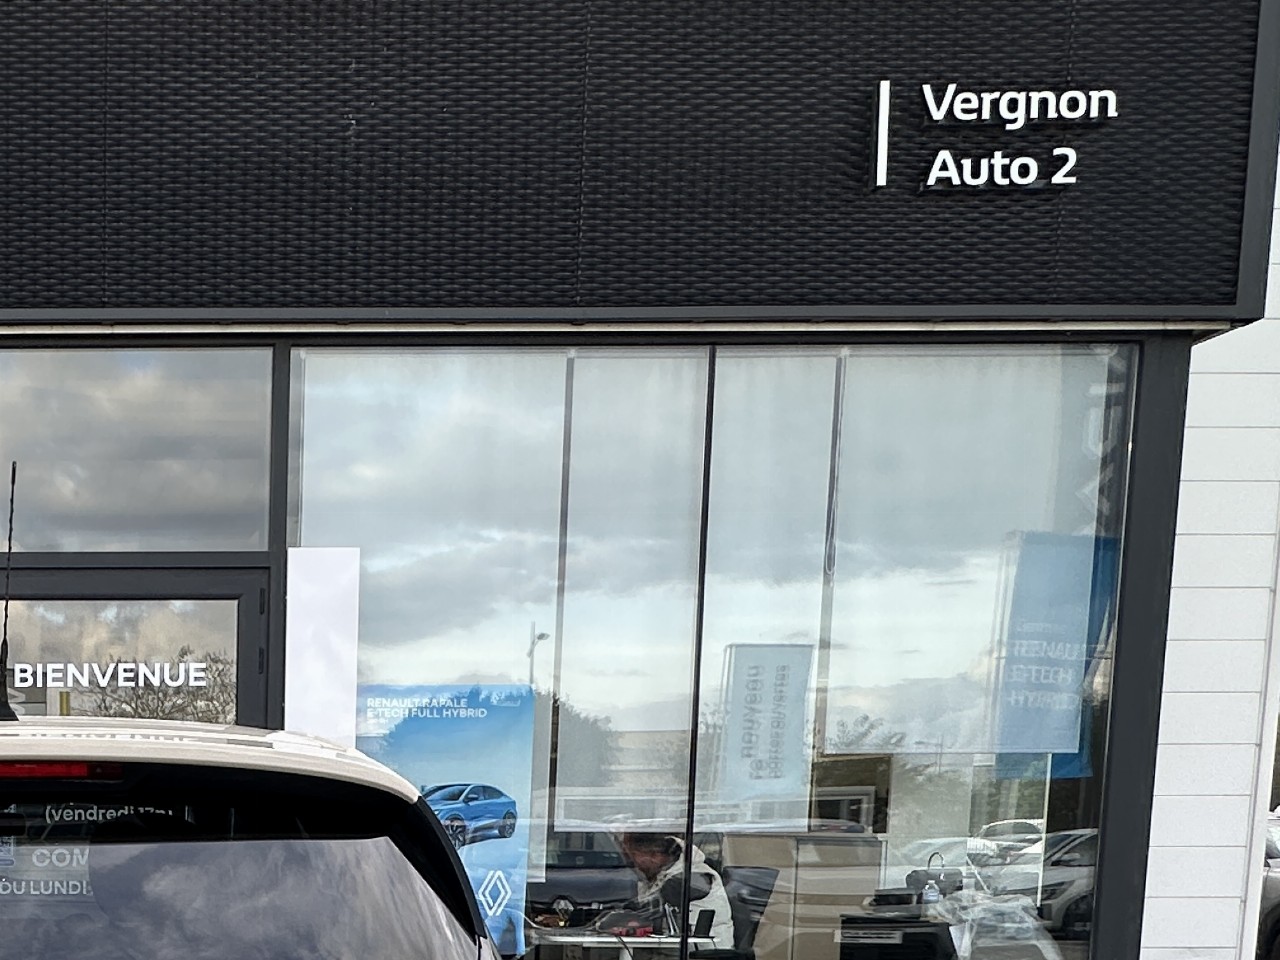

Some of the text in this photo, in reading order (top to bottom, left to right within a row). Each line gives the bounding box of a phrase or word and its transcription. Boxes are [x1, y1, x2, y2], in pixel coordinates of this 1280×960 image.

[922, 83, 1118, 130] Vergnon
[926, 147, 1077, 185] Auto 2
[13, 662, 208, 688] BIENVENUE
[411, 708, 440, 718] FULL
[443, 708, 488, 718] HYBRID
[0, 880, 87, 895] DU LUNDI
